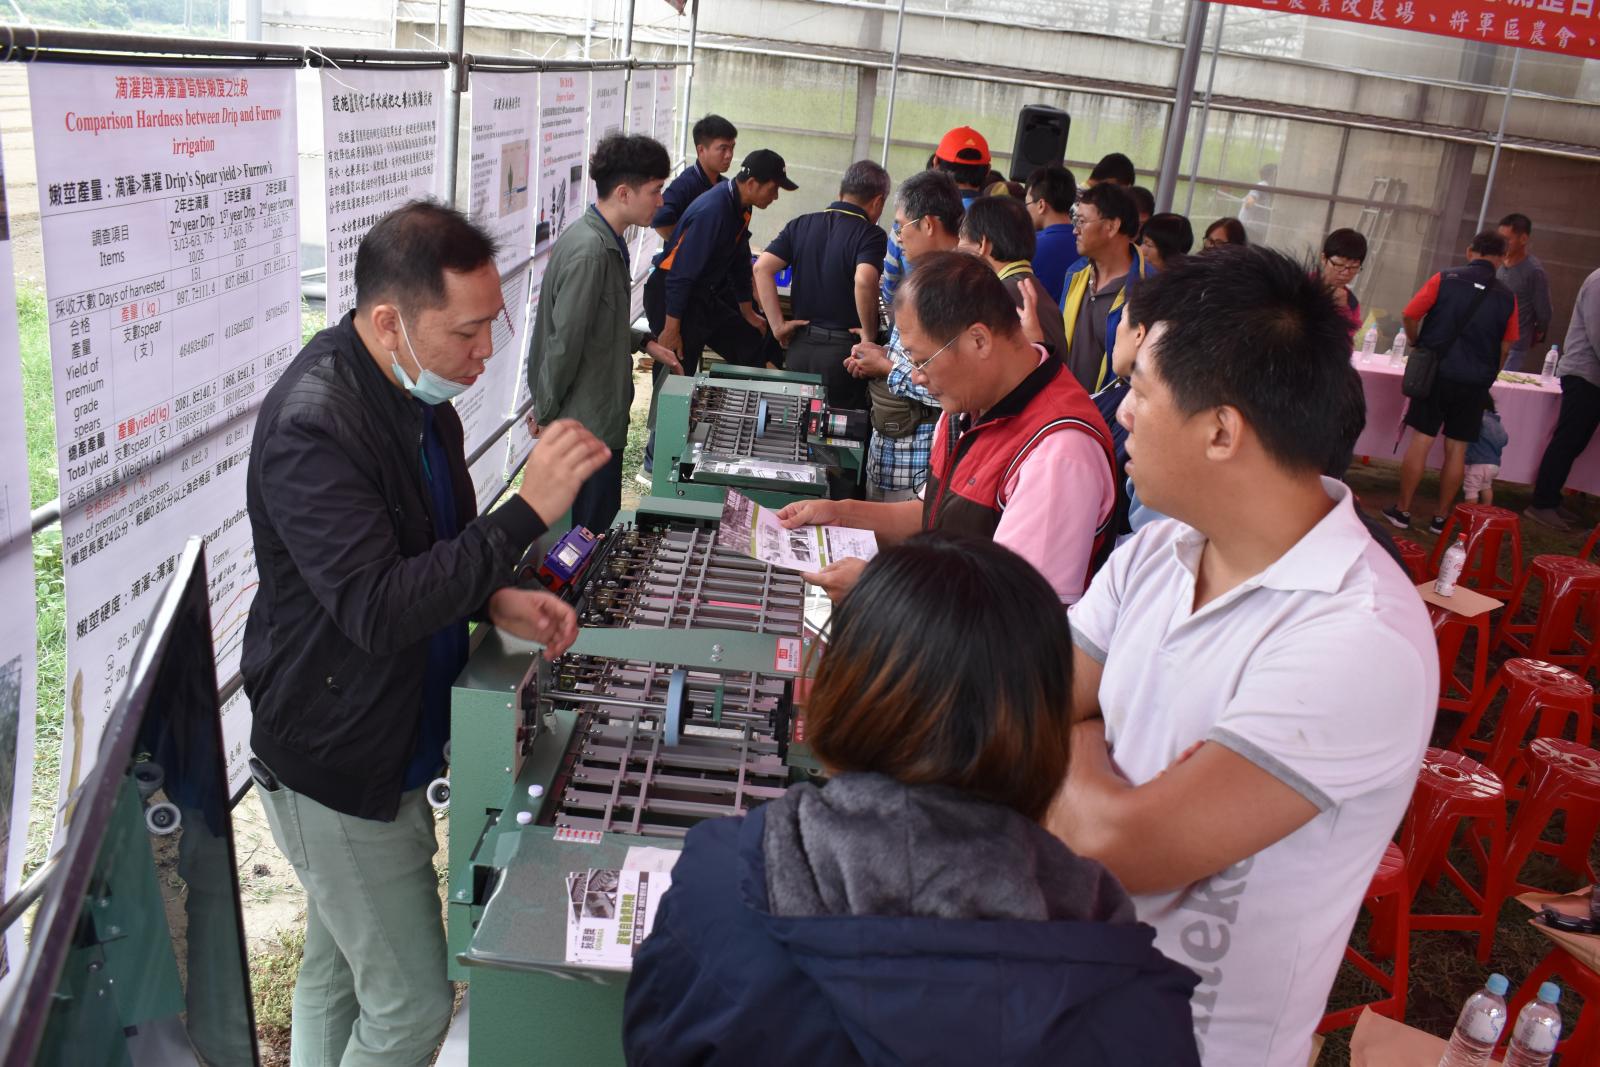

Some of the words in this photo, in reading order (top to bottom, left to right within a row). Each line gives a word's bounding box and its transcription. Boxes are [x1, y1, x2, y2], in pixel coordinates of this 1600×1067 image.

[65, 111, 133, 135] Comparison
[136, 109, 183, 128] Hardness
[186, 109, 220, 126] between
[222, 107, 238, 127] Drip
[240, 106, 254, 121] and
[255, 106, 281, 121] Furrow
[172, 136, 215, 158] irrigation
[194, 170, 217, 189] Spear
[219, 165, 236, 186] yield
[170, 218, 181, 235] 2nd
[183, 221, 198, 235] year
[200, 214, 215, 229] Drip
[229, 213, 242, 226] year
[243, 205, 256, 220] Drip
[99, 250, 125, 267] Items
[98, 291, 119, 308] Days
[120, 285, 129, 301] of
[129, 276, 165, 298] harvested
[66, 362, 88, 381] Yield
[90, 357, 99, 373] of
[65, 378, 104, 405] premium
[74, 399, 99, 422] grade
[74, 418, 101, 440] spears
[67, 466, 88, 482] Total
[89, 451, 109, 475] yield
[121, 455, 150, 479] Weight
[66, 531, 84, 550] Rate
[85, 521, 94, 539] of
[95, 507, 127, 537] premium
[128, 494, 147, 517] grade
[149, 481, 170, 502] spears
